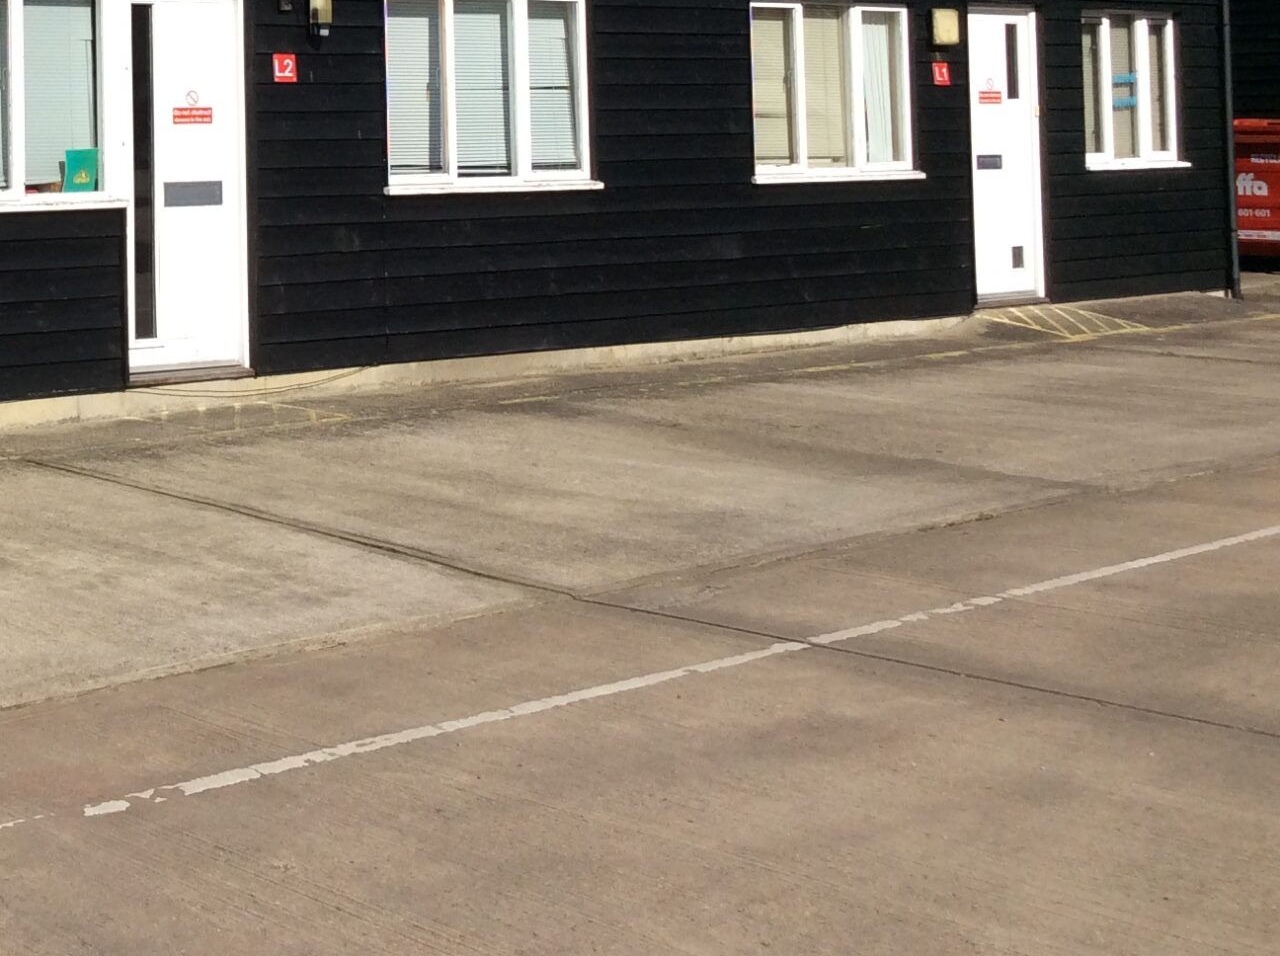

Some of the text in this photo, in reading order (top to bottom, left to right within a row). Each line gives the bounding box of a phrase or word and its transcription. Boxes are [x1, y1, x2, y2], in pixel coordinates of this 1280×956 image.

[274, 59, 293, 77] L2
[934, 65, 948, 81] L1
[1236, 172, 1269, 196] ffa
